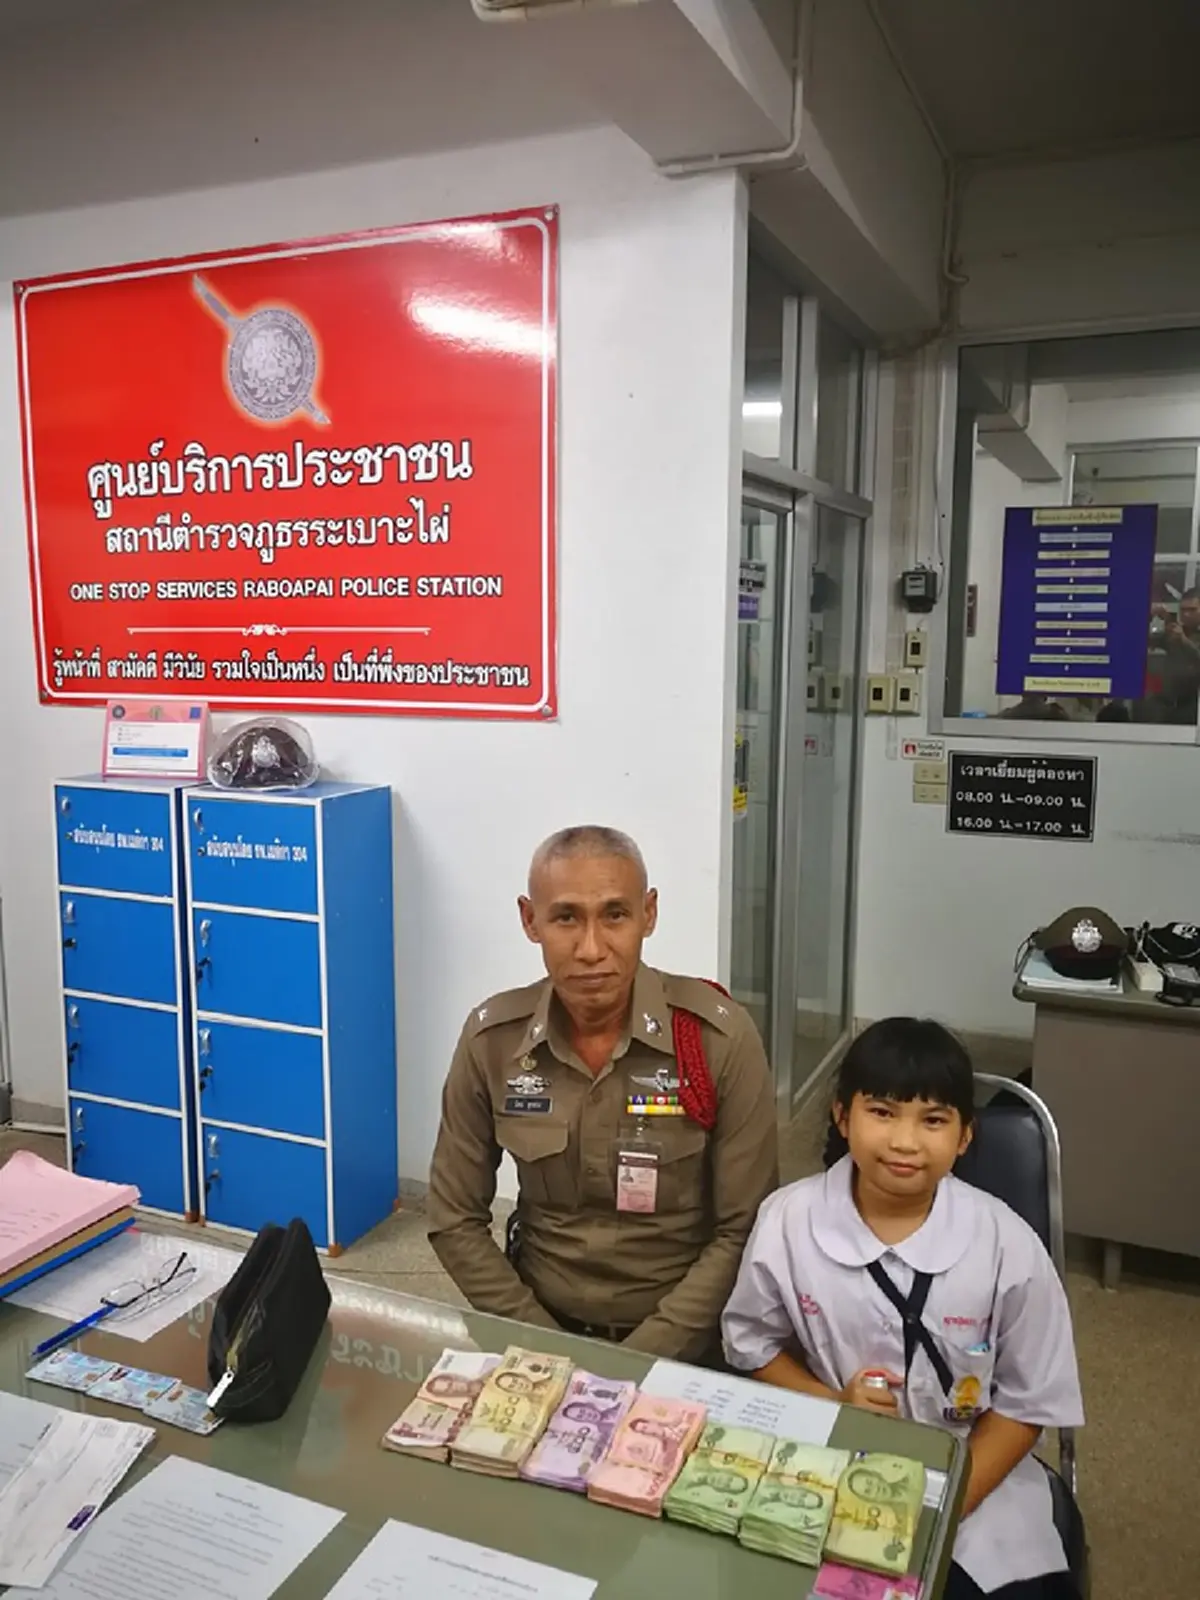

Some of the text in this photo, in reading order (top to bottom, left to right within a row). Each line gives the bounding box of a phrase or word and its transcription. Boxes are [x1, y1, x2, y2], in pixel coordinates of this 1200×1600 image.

[87, 439, 473, 518] ศูนย์บริการประชาชน
[105, 497, 450, 564] สถานีตำรวจภูธรระเบาะไผ่
[70, 576, 503, 600] ONE STOP SERVICES RABOAPAI POLICE STATION
[53, 647, 530, 687] รู้หน้าที่ สามัคคี มีวินัย รวมใจเป็นหนึ่ง เป็นที่พึ่งของประชาชน
[956, 790, 994, 803] 08.00
[956, 816, 993, 829] 16.00
